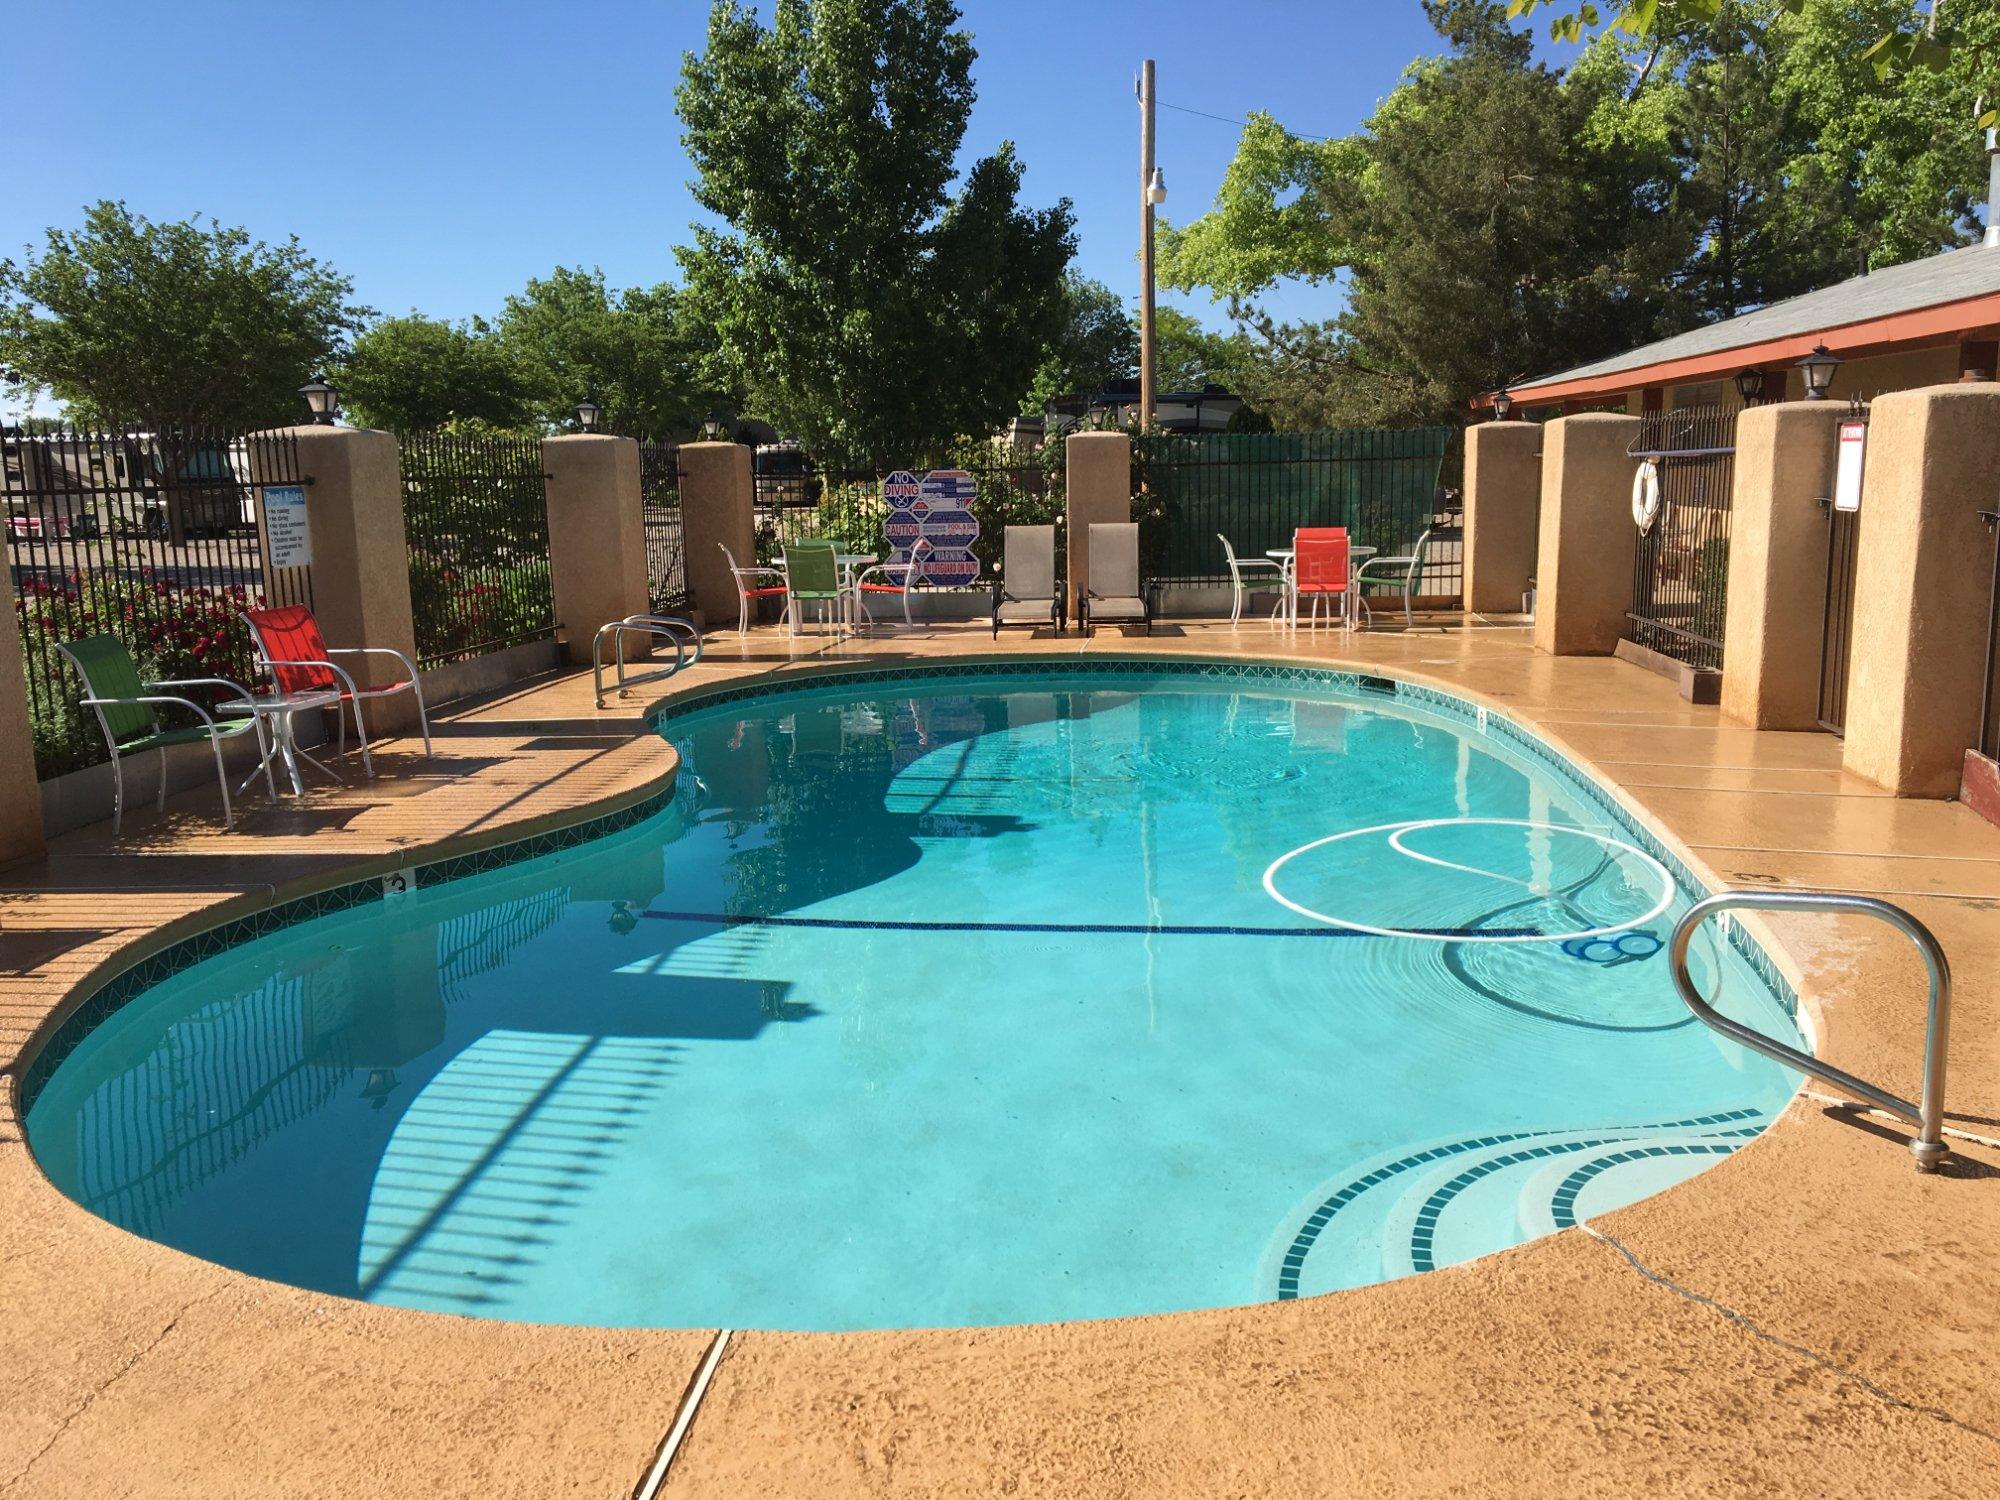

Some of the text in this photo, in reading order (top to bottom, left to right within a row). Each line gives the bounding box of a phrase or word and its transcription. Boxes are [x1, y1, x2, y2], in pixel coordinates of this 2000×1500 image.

[894, 473, 909, 484] NO
[884, 484, 919, 496] DIVING
[266, 491, 282, 503] Pool
[955, 498, 966, 509] 911
[885, 524, 919, 536] CAUTION
[934, 550, 967, 562] WARNING
